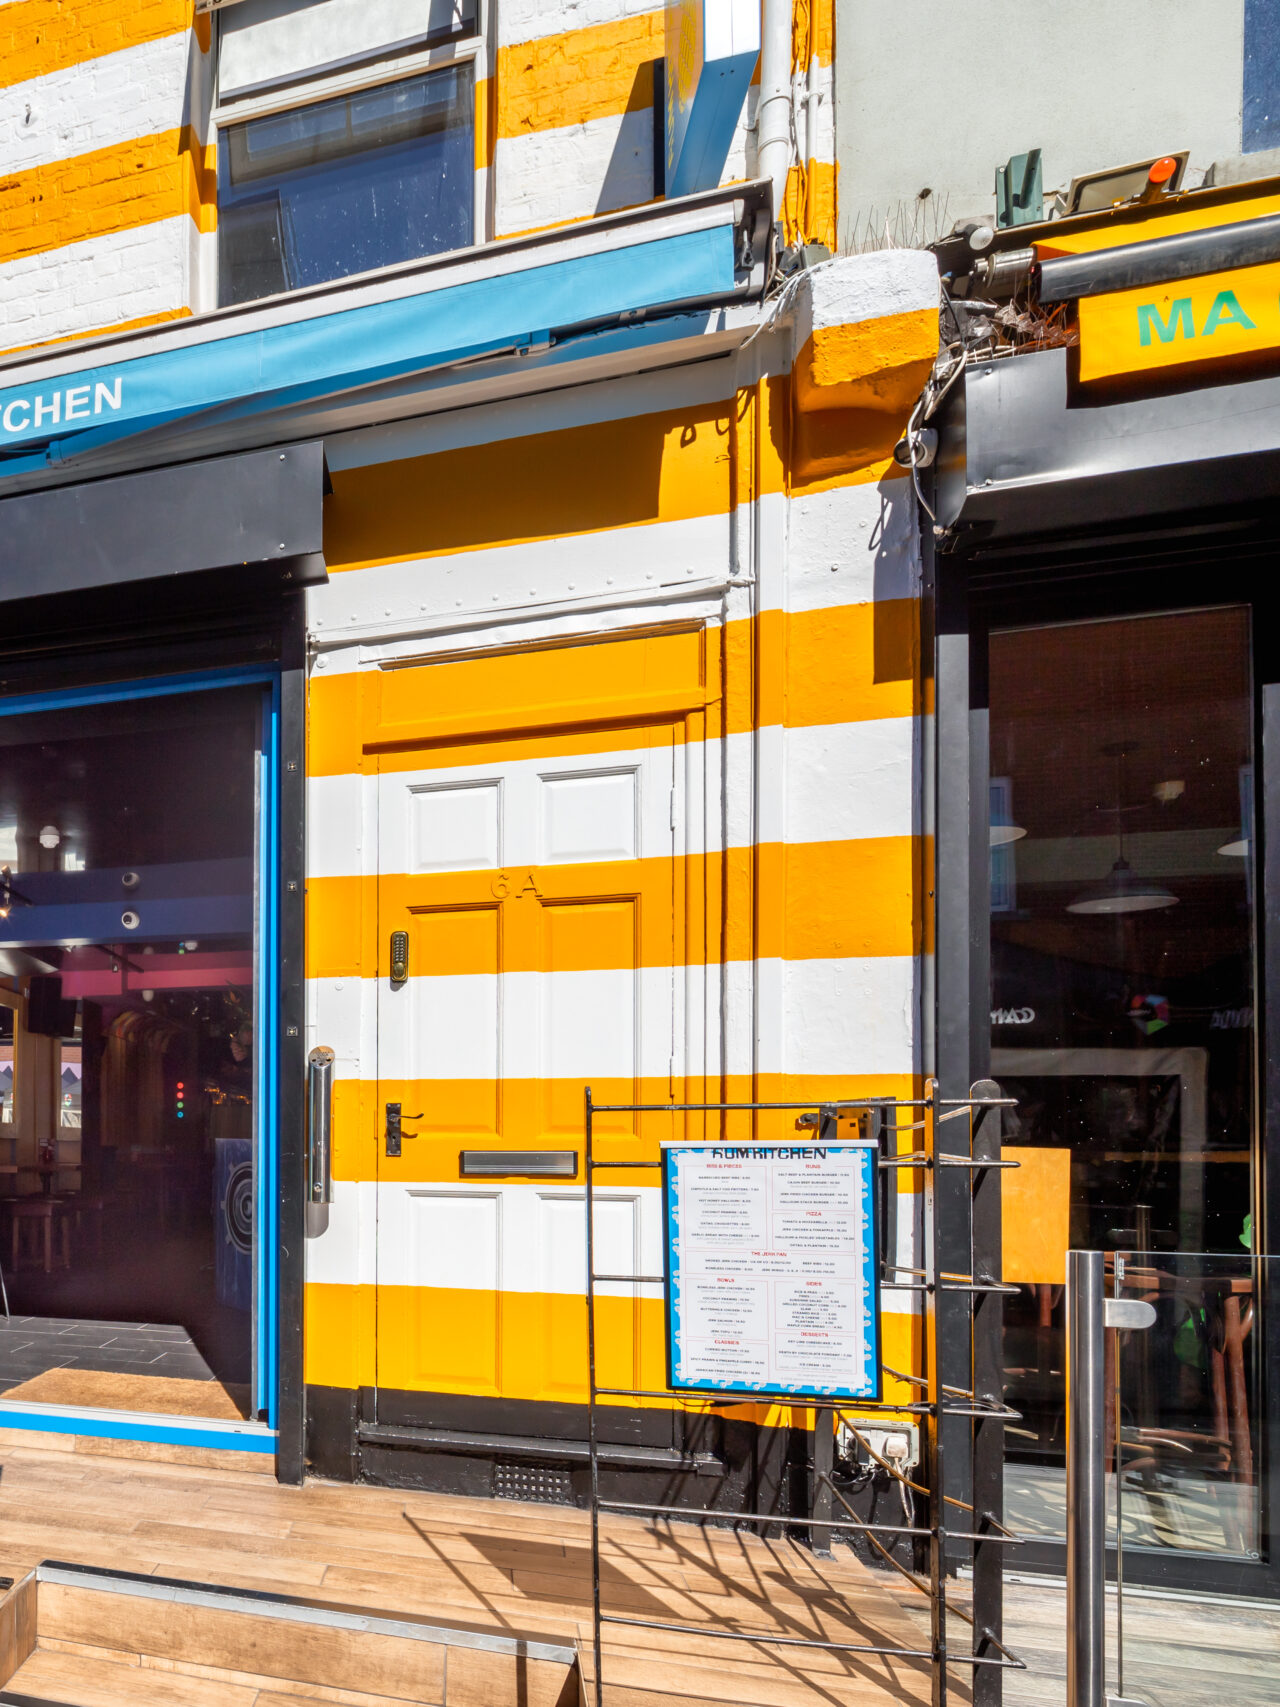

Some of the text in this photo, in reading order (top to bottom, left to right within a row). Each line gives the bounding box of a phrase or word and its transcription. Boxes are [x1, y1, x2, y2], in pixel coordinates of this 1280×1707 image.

[1137, 289, 1258, 347] MA
[490, 871, 544, 900] 6A
[712, 1147, 827, 1160] RUM KITCHEN
